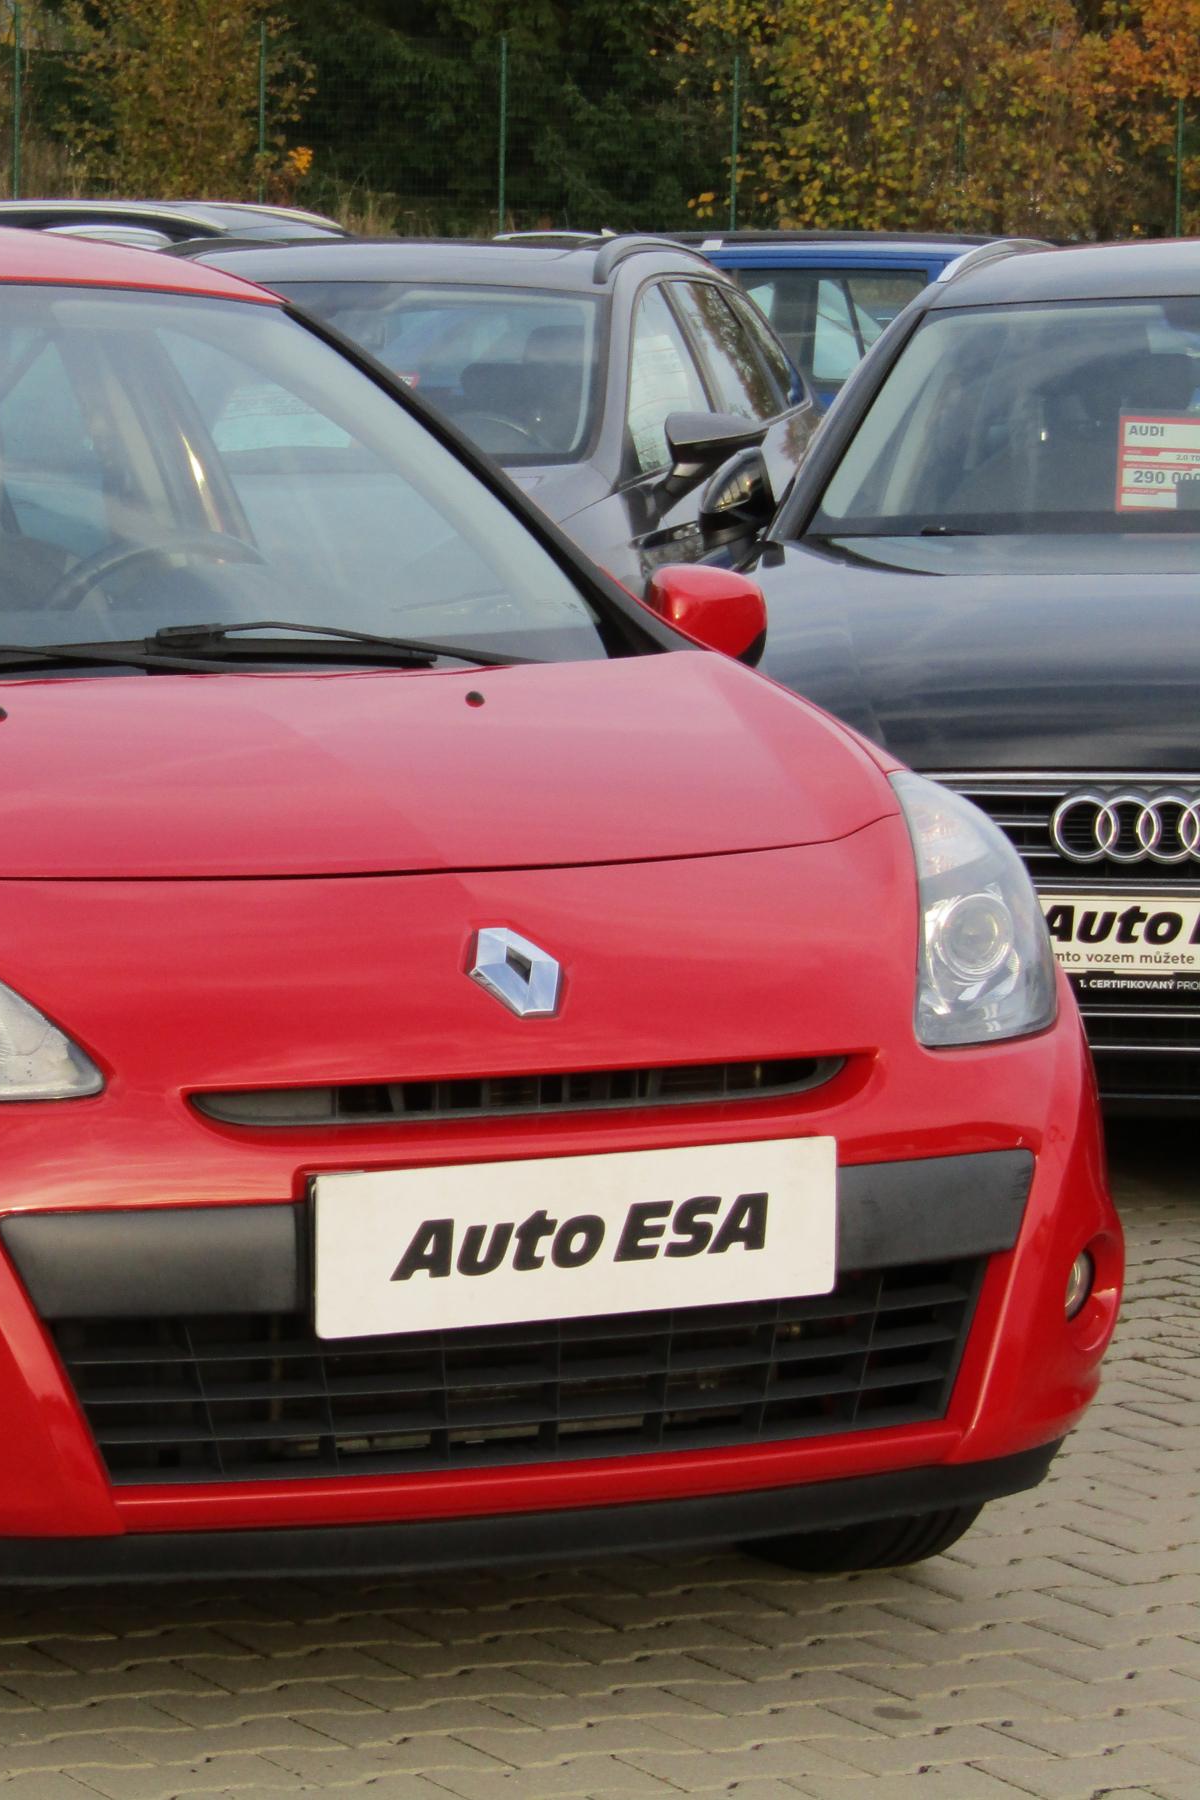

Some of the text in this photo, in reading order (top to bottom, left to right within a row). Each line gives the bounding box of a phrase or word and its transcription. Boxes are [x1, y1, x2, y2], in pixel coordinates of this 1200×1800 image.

[1129, 425, 1165, 437] AUDI
[1133, 470, 1165, 484] 290
[1046, 904, 1183, 945] Auto
[1086, 953, 1134, 963] vozem
[1139, 951, 1195, 964] můžete
[1089, 979, 1175, 989] CERTIFIKOVANÝ
[389, 1192, 769, 1282] Auto ESA
